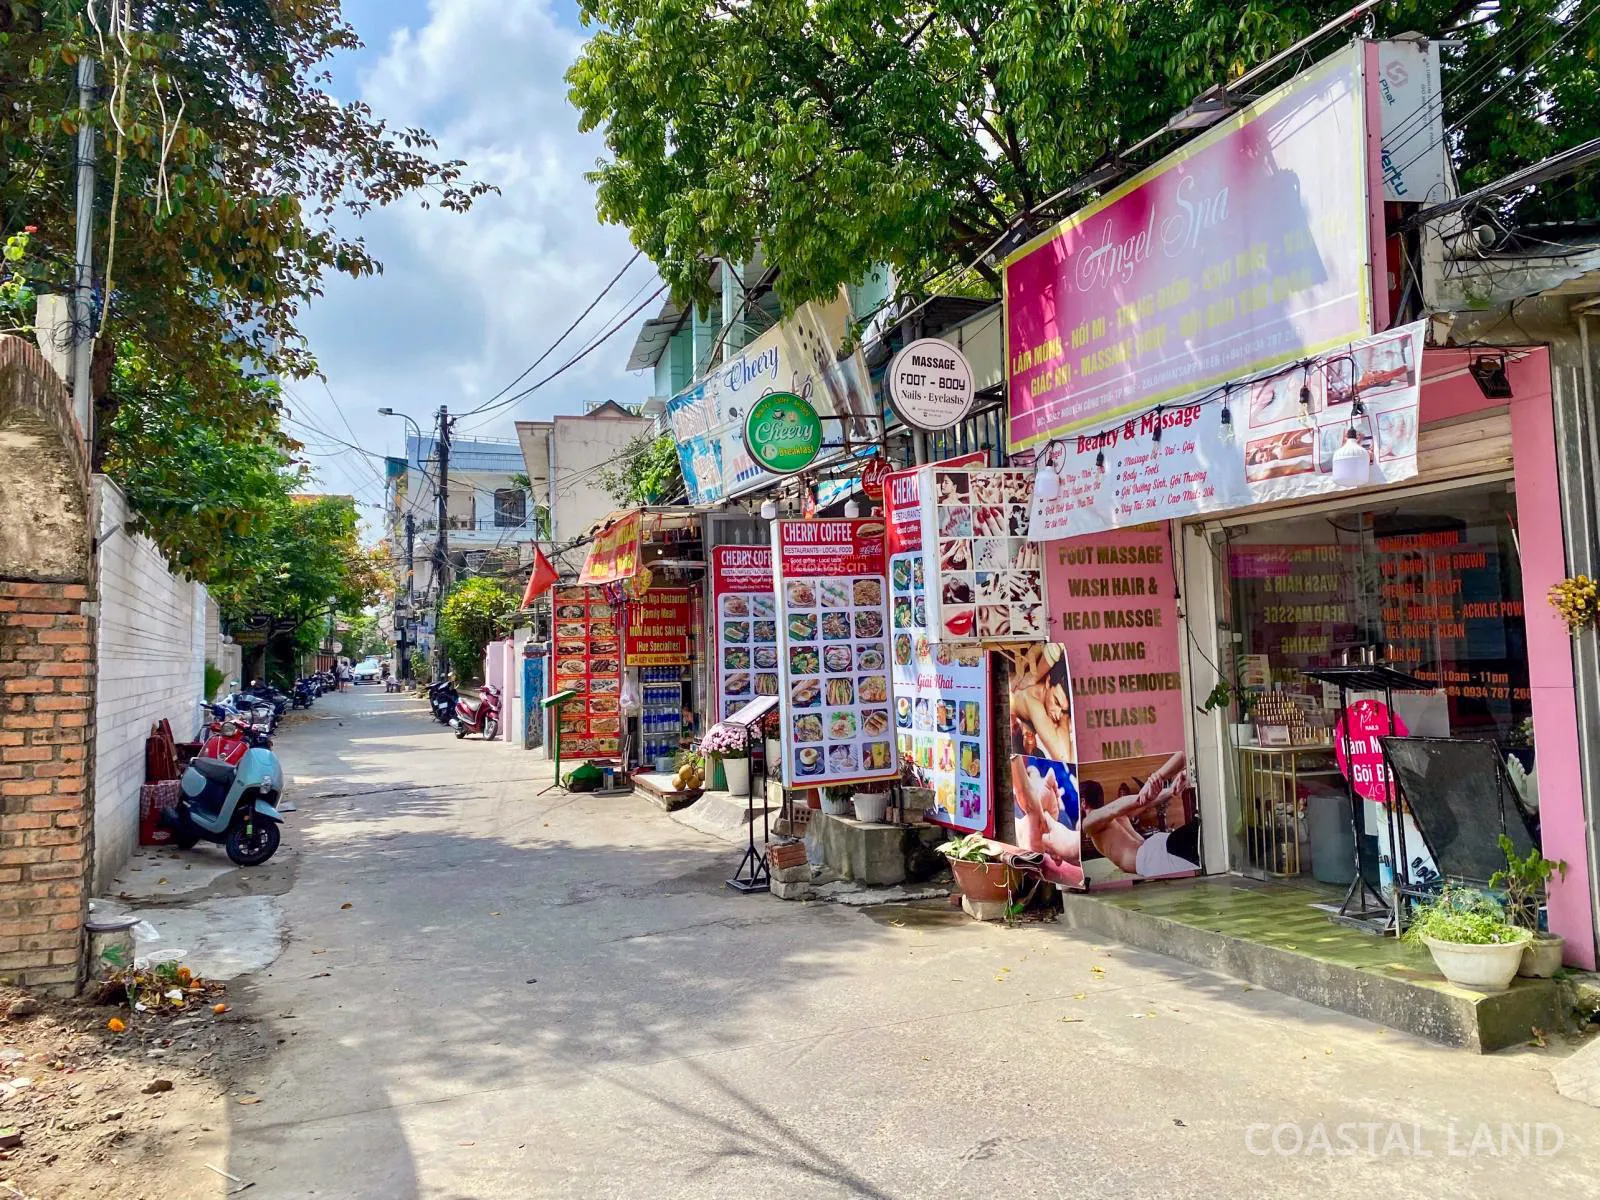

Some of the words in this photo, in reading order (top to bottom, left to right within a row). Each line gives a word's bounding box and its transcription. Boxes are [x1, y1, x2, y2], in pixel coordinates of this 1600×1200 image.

[1076, 202, 1154, 292] Angel
[1161, 175, 1228, 258] Spa
[724, 344, 779, 391] Cheery
[912, 355, 956, 370] MASSAGE
[900, 372, 927, 386] FOOT
[939, 377, 966, 390] BODY
[900, 389, 922, 400] Nails
[928, 392, 964, 405] Eyelashs
[1076, 427, 1120, 454] Beauty
[1123, 420, 1136, 440] &
[1140, 404, 1201, 435] Massage
[784, 522, 818, 542] CHERRY
[821, 522, 852, 541] COFFEE
[721, 550, 751, 566] CHERRY
[785, 546, 819, 554] RESTAURANTS
[1058, 545, 1093, 565] FOOT
[1097, 545, 1164, 565] MASSAGE
[1068, 577, 1109, 597] WASH
[1112, 577, 1145, 596] HAIR
[1148, 577, 1158, 594] &
[1063, 611, 1101, 631] HEAD
[1104, 608, 1162, 629] MASSGE
[1088, 641, 1146, 662] WAXING
[1479, 671, 1509, 684] 11pm
[1463, 686, 1489, 698] 0934
[1490, 687, 1511, 699] 787
[1353, 763, 1373, 785] Gội
